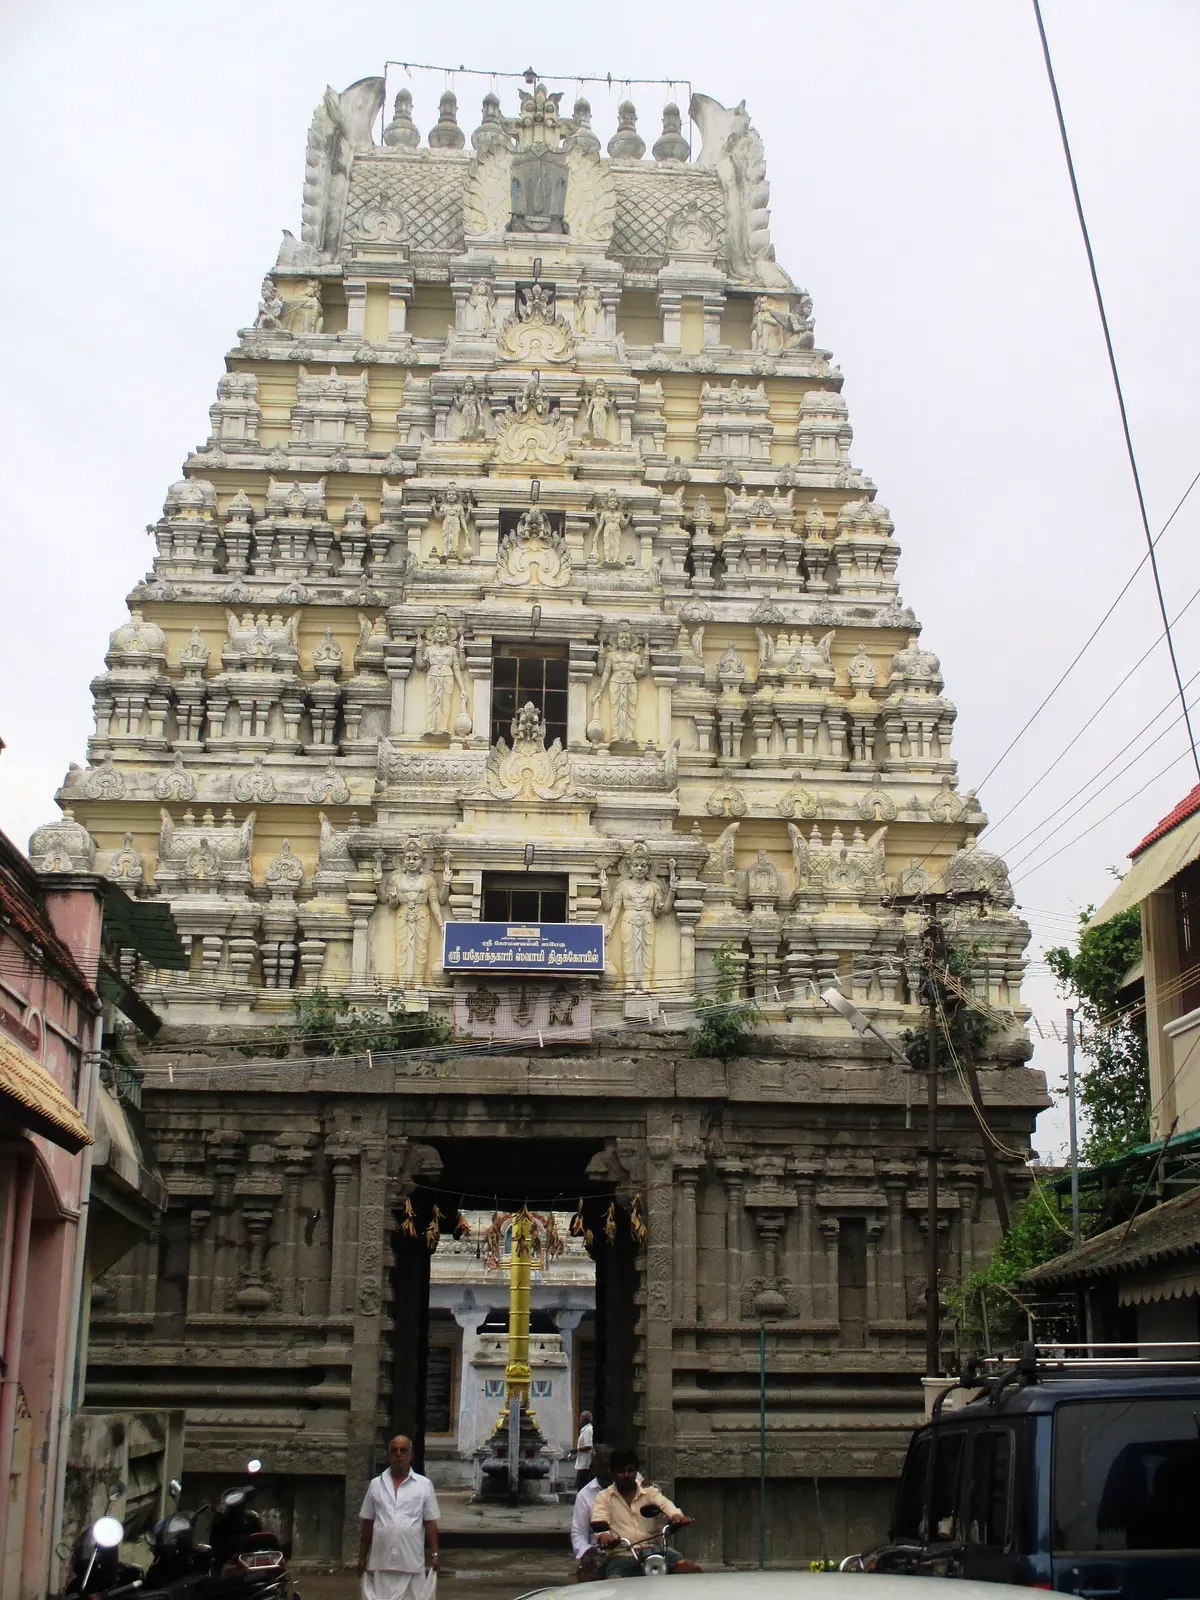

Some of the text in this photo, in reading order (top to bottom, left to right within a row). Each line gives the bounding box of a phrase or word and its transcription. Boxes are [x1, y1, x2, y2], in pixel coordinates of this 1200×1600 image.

[448, 946, 599, 965] ஸ்ரீ யதோக்தகாரி ஸ்வாமி திருக்கோயில்
